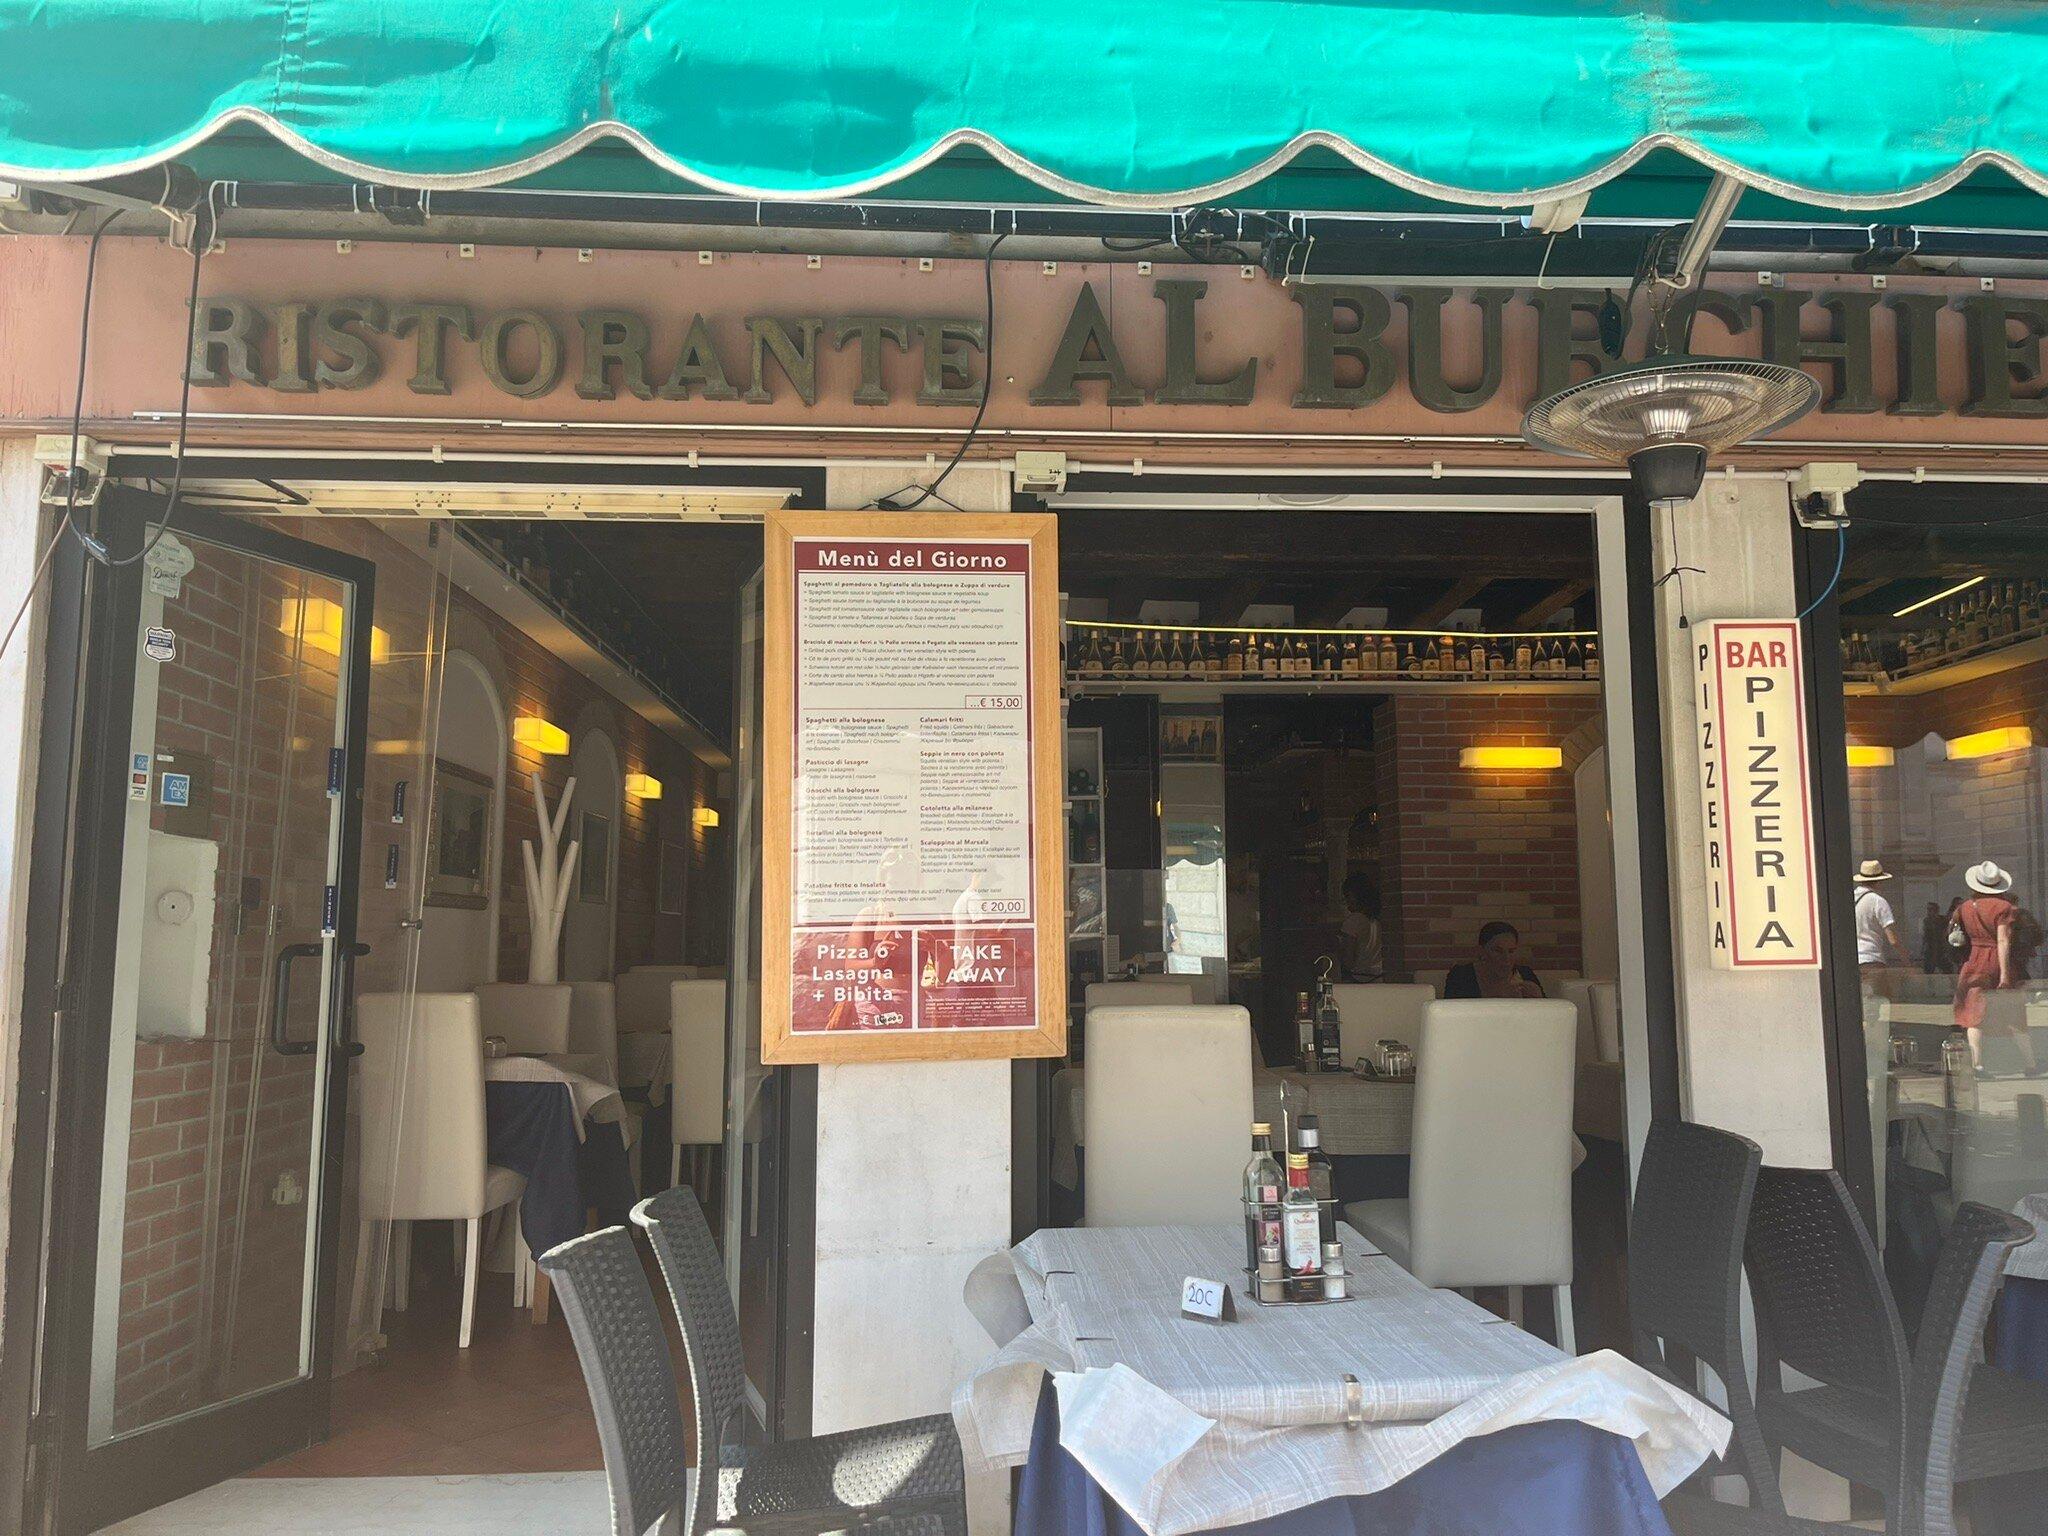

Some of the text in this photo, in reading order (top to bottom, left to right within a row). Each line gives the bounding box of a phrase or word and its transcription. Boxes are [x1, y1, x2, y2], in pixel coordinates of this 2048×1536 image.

[182, 296, 986, 406] RISTORANTE
[1029, 280, 1257, 407] AL
[818, 549, 1007, 568] Menù del Giorno
[1725, 641, 1788, 669] BAR
[990, 698, 1020, 708] 15,00
[170, 780, 187, 790] AM
[172, 789, 187, 799] EX
[1698, 643, 1726, 949] PIZZERIA
[1745, 676, 1795, 949] PIZZERIA
[849, 829, 882, 837] bolognese
[981, 902, 1021, 913] € 20,00
[817, 944, 869, 960] Pizza
[949, 944, 1002, 960] TAKE
[812, 966, 893, 984] Lasagna
[945, 967, 1007, 983] AWAY
[812, 985, 893, 1002] + Bibita
